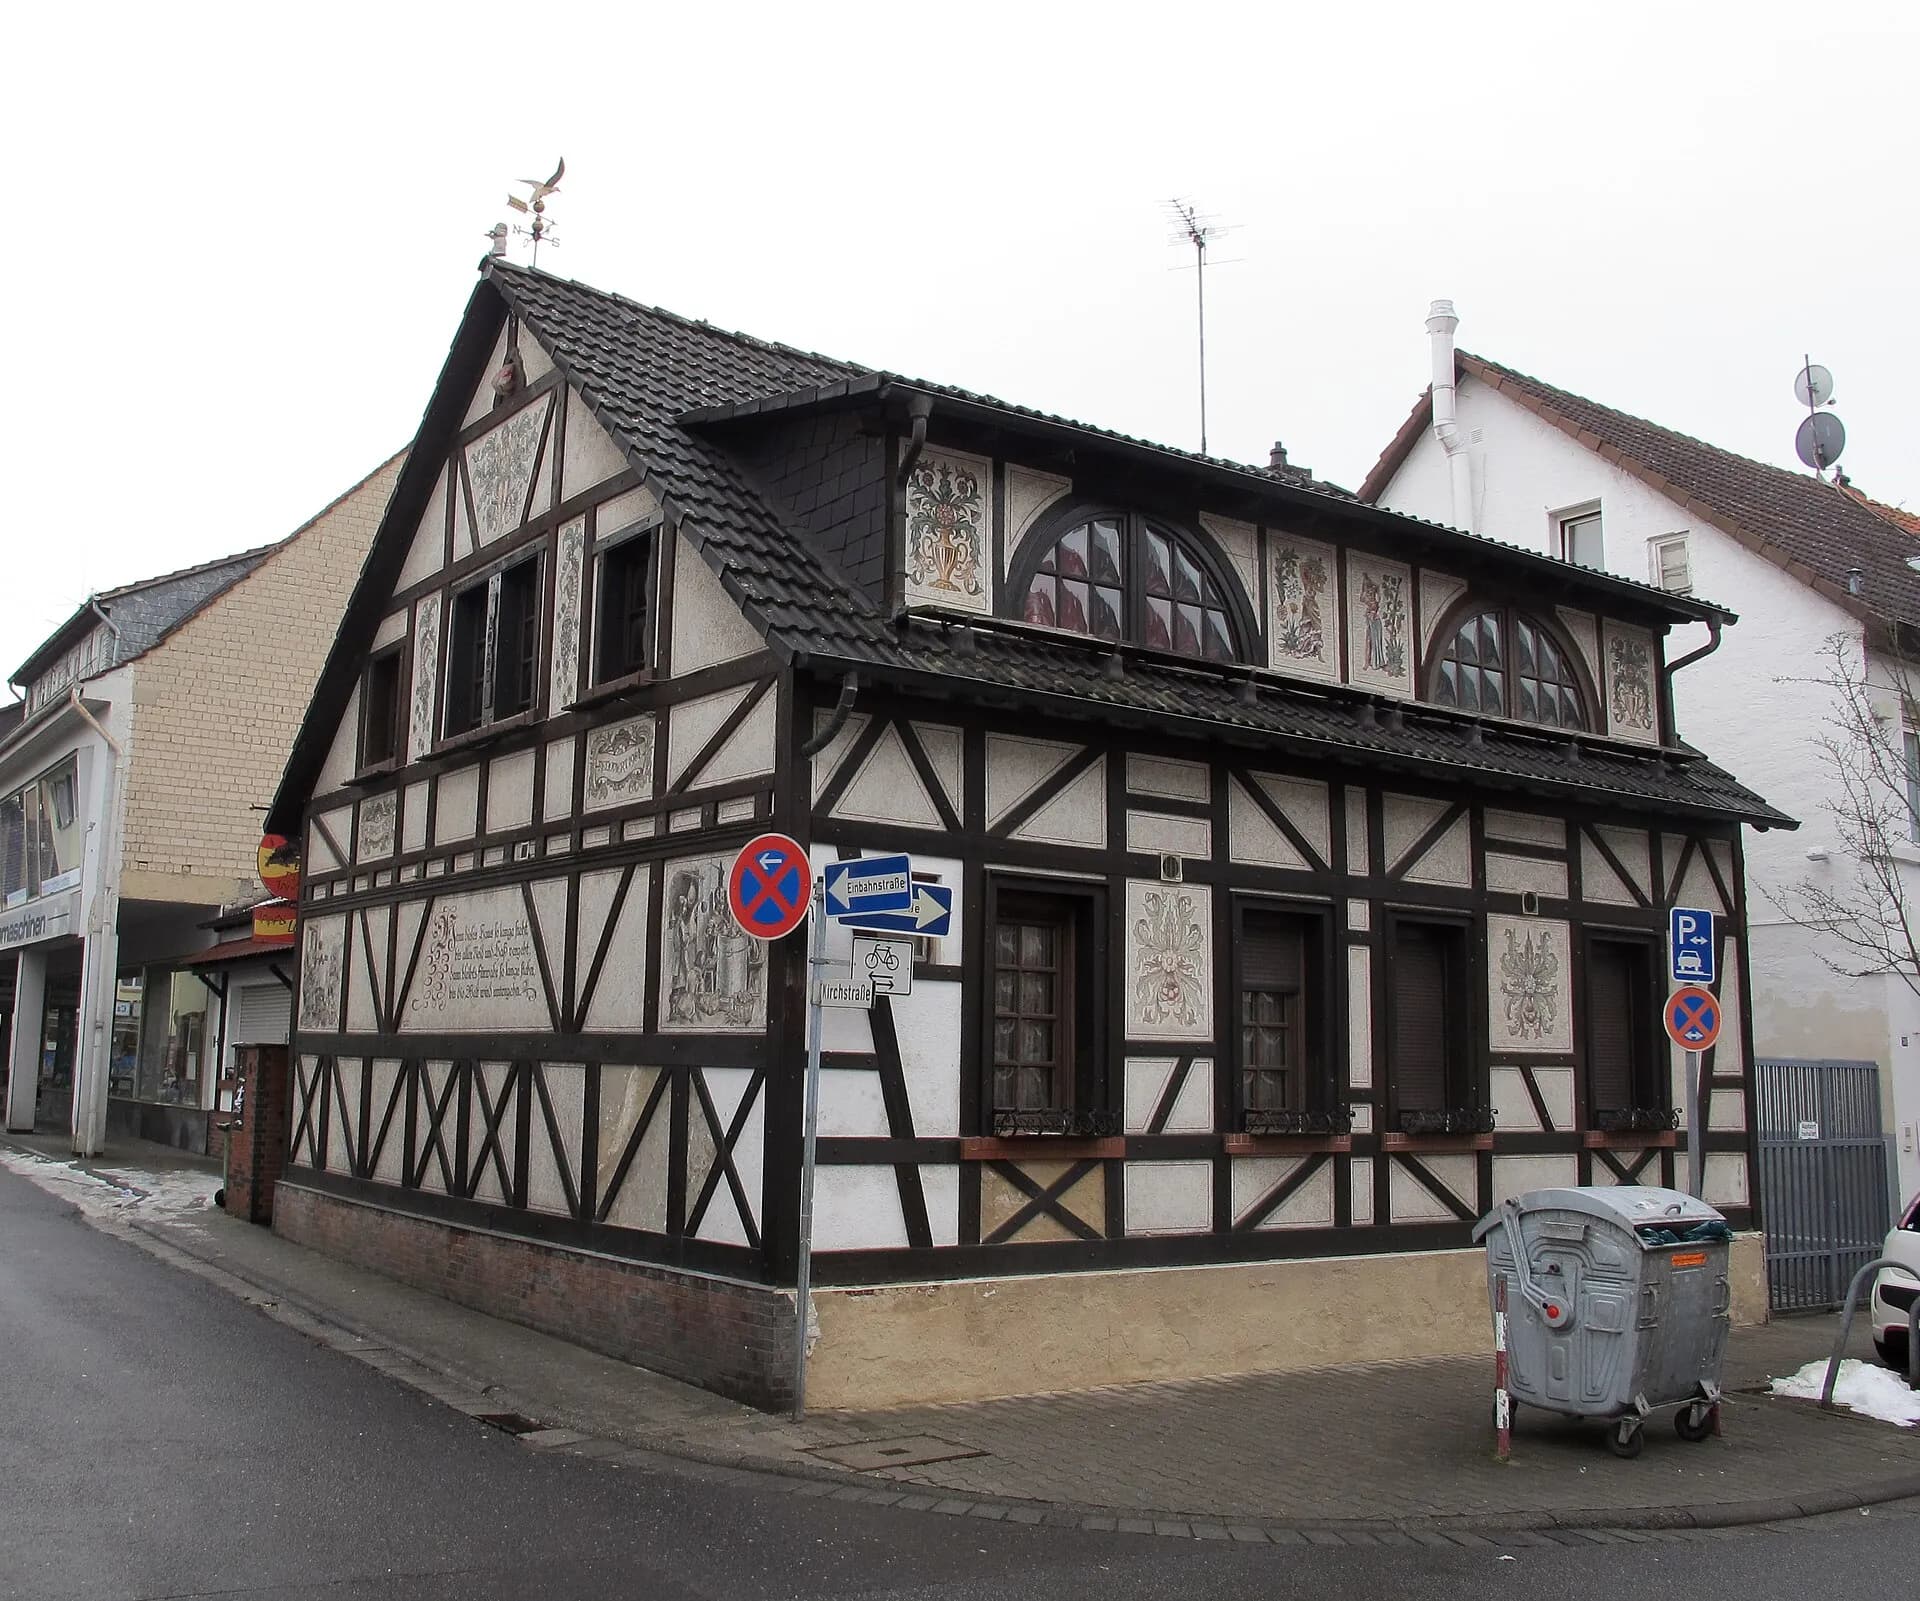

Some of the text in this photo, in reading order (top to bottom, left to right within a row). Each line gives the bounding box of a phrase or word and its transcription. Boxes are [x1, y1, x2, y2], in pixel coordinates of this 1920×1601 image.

[847, 877, 905, 894] Einbahnstraße
[0, 913, 46, 945] maschinen
[1678, 915, 1696, 945] P
[821, 983, 871, 1001] Kirchstraße
